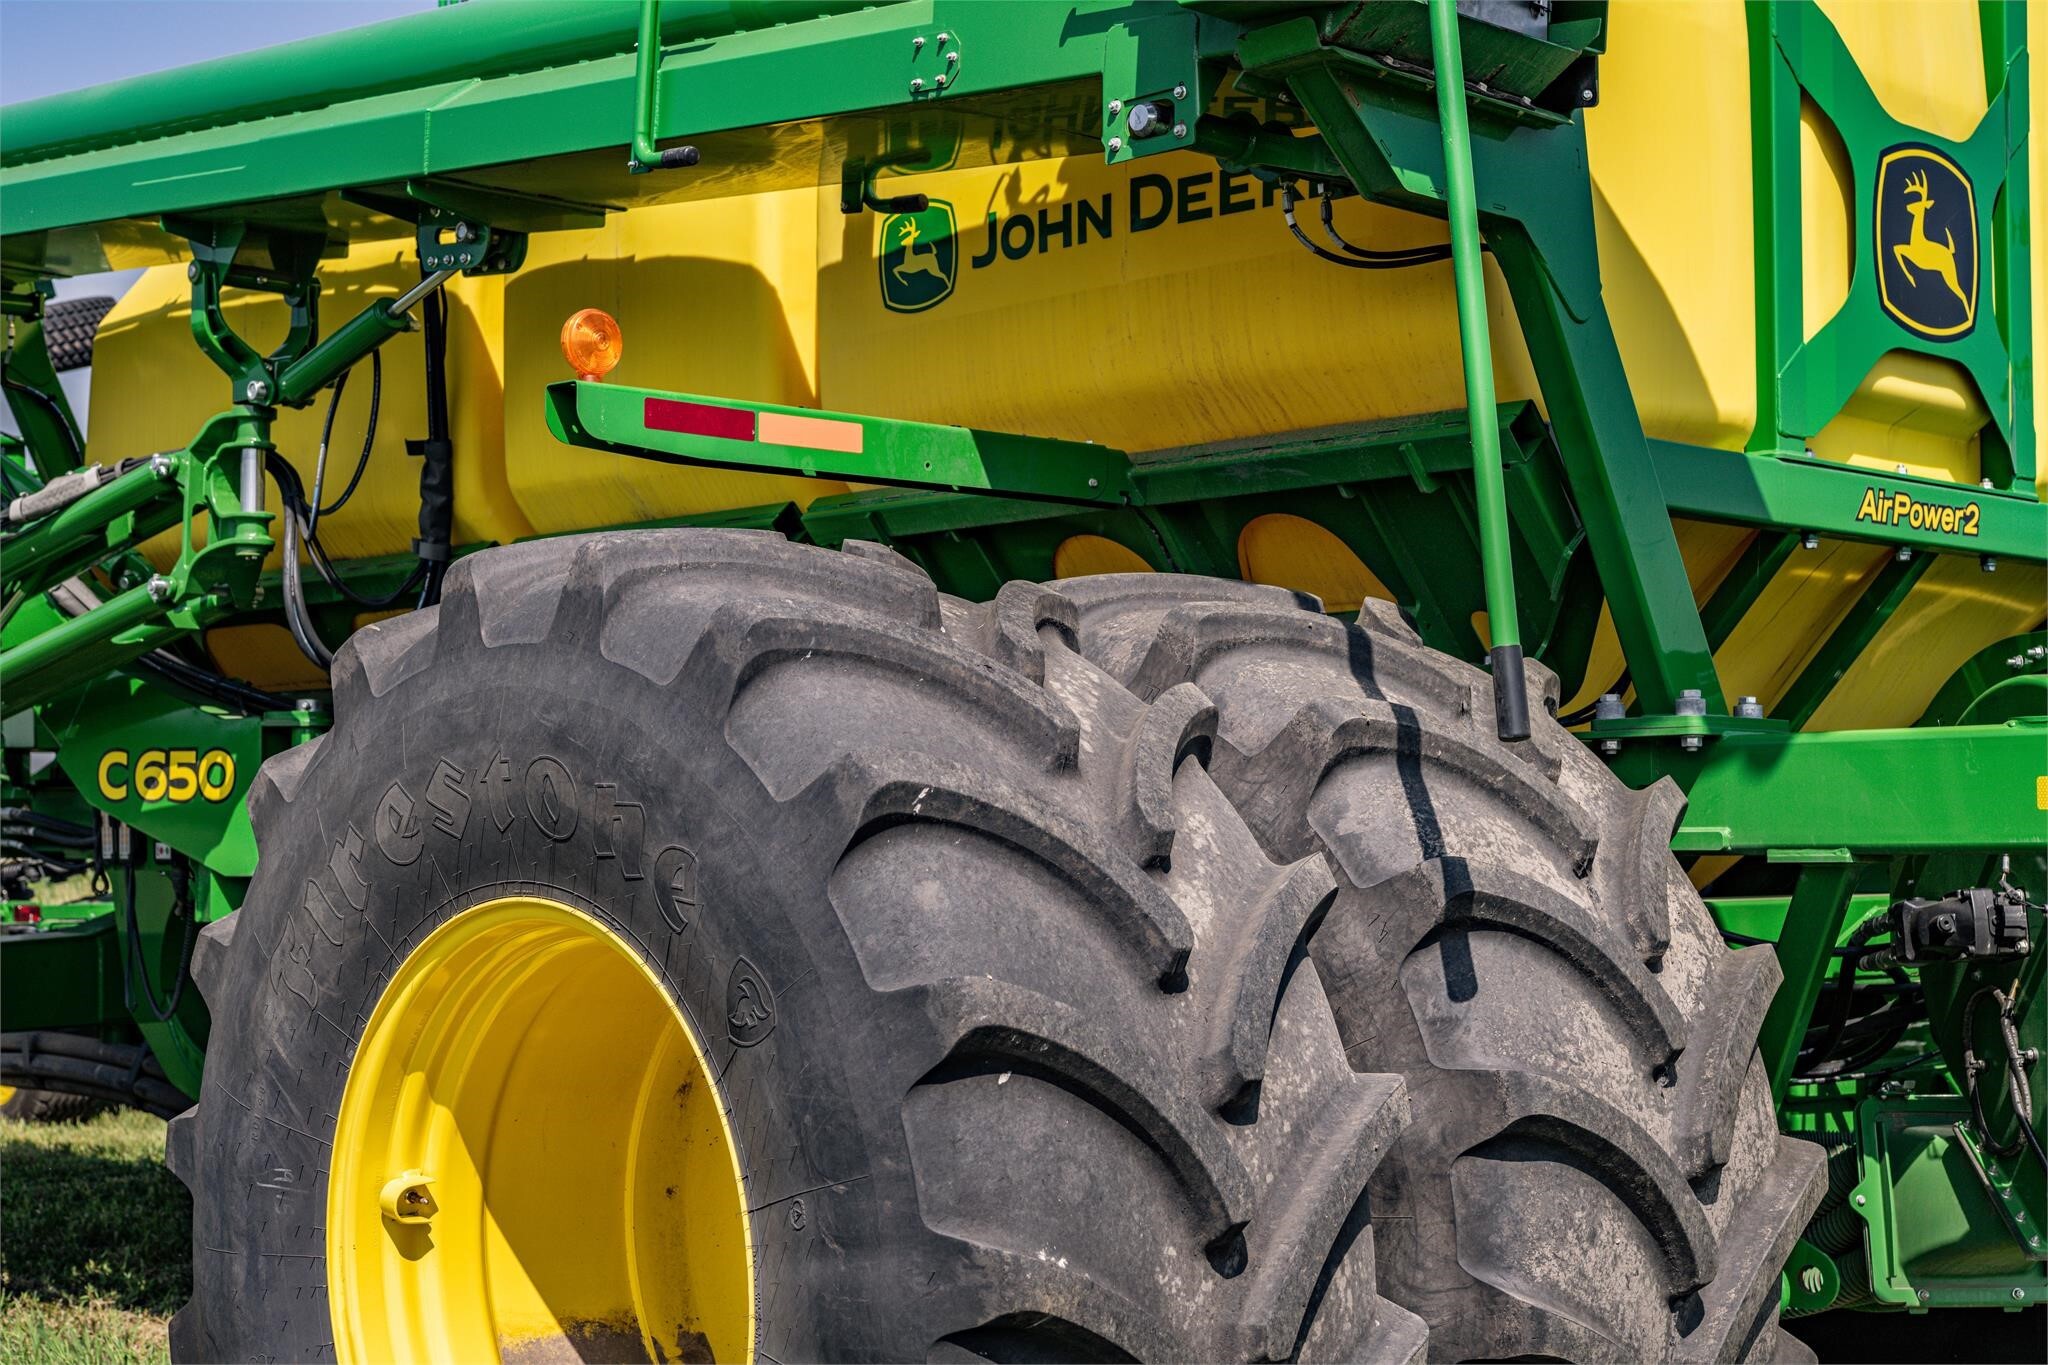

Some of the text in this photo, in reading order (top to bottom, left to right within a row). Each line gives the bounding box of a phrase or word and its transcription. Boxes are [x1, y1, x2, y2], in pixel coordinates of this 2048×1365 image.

[971, 193, 1112, 269] JOHN
[1857, 487, 1980, 536] AirPower2
[98, 748, 236, 803] C 650
[269, 749, 699, 1012] Firestone
